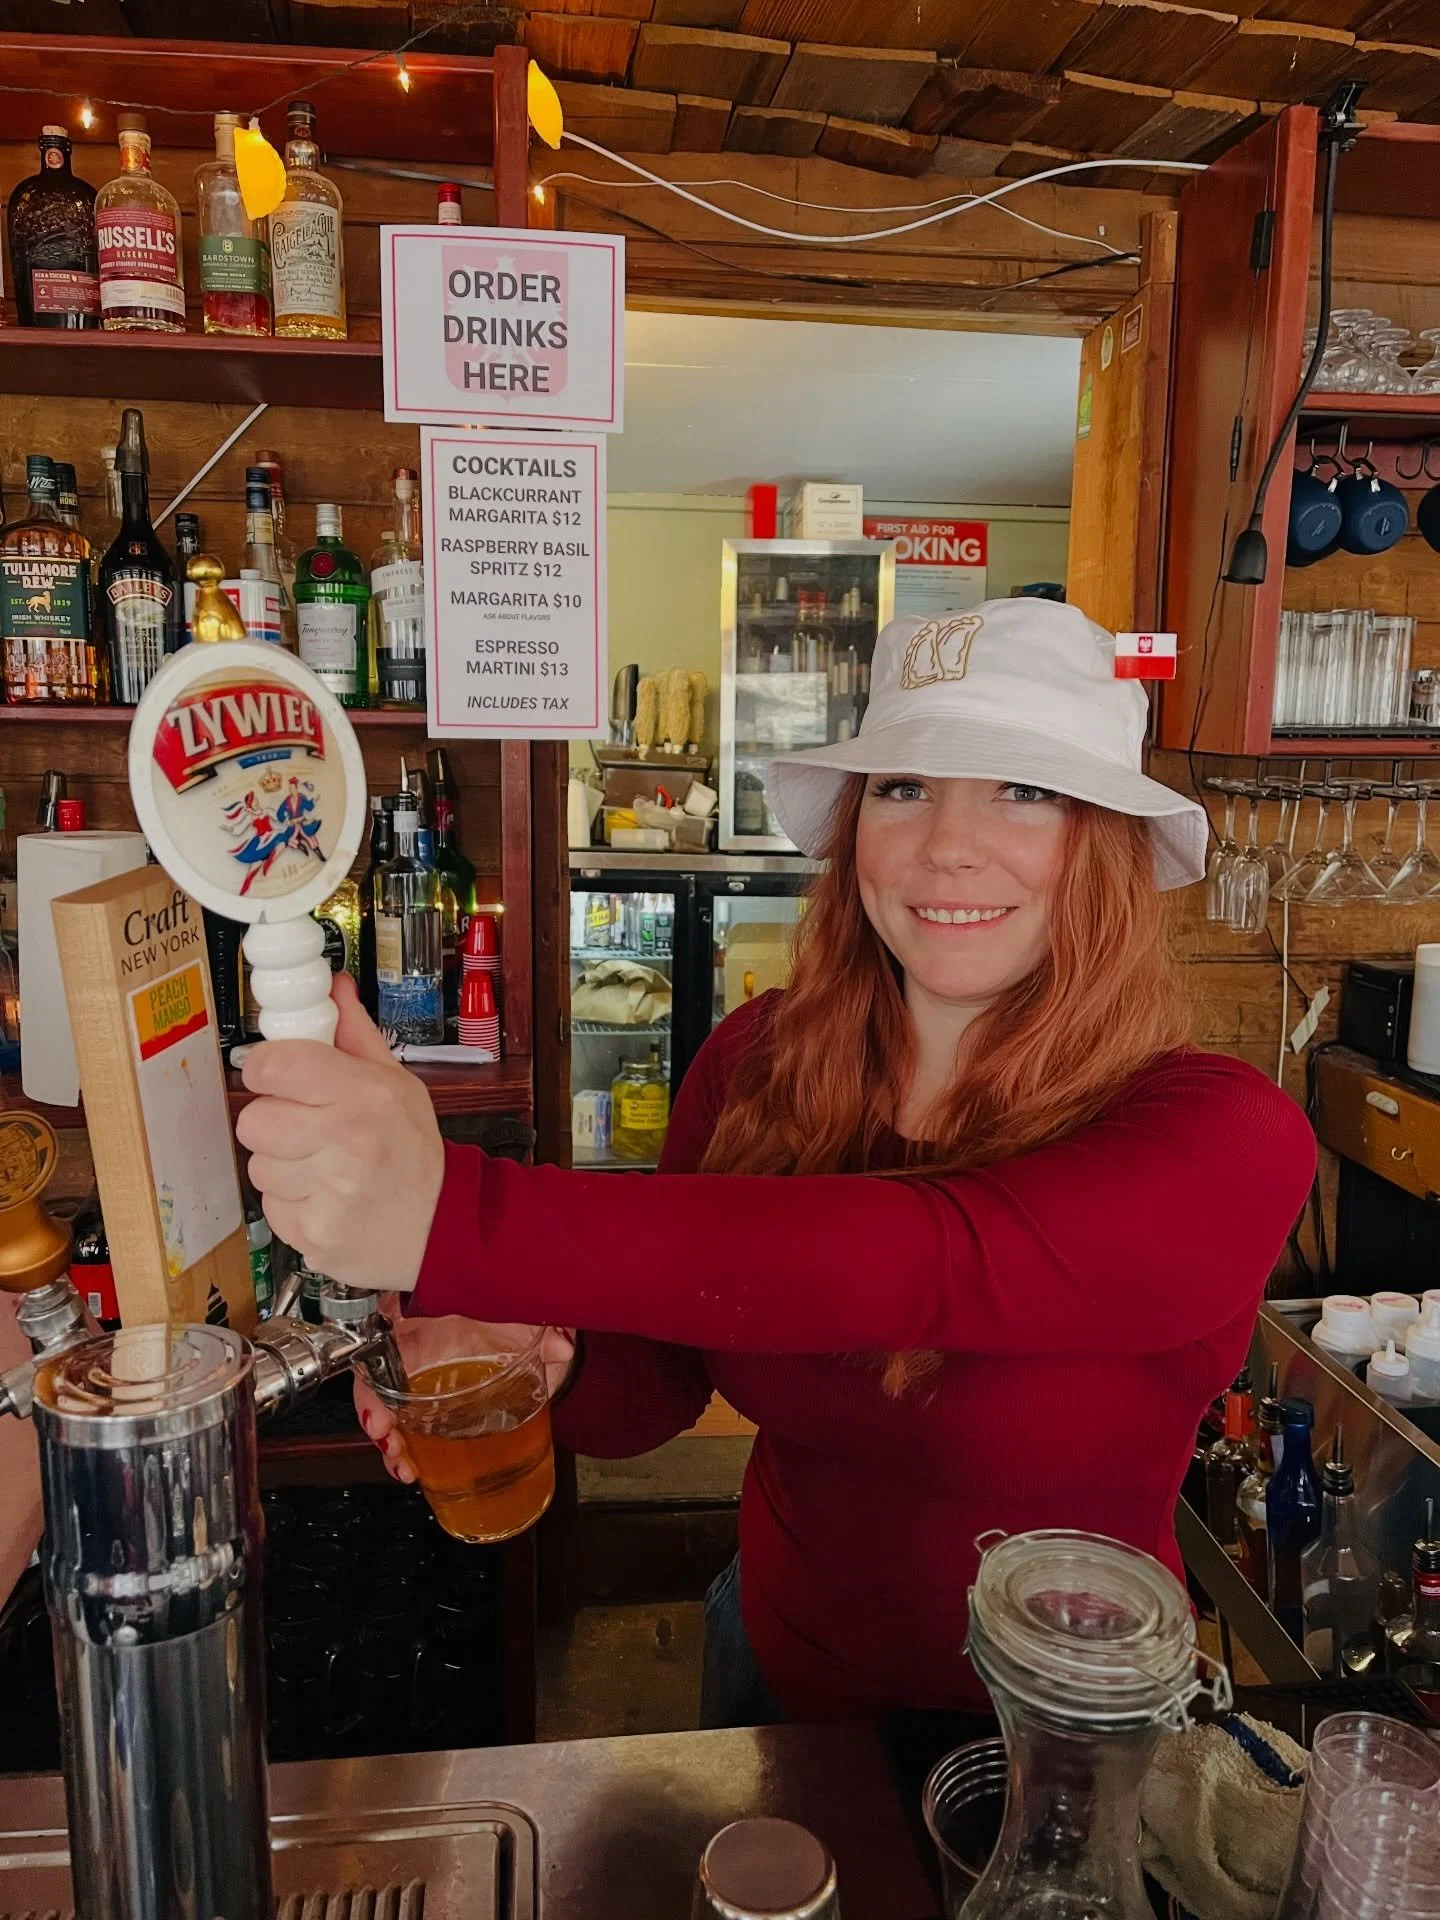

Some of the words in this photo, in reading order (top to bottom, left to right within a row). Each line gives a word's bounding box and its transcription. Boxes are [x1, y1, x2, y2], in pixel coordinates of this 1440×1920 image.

[98, 226, 175, 255] RUSSELL'S
[202, 254, 254, 264] BARDSTOWN
[448, 269, 561, 304] ORDER
[444, 314, 568, 350] DRINKS
[464, 361, 550, 393] HERE
[452, 455, 577, 478] COCKTAILS
[448, 485, 582, 504] BLACKCURRANT
[449, 507, 548, 524] MARGARITA
[552, 510, 582, 526] $12
[876, 523, 907, 533] FIRST
[910, 523, 930, 534] AID
[932, 525, 955, 536] FOR
[441, 537, 538, 555] RASPBERRY
[543, 542, 590, 557] BASIL
[2, 562, 77, 578] TULLAMORE
[470, 560, 528, 576] SPRITZ
[533, 562, 562, 578] $12
[110, 581, 168, 599] BAILEYS
[450, 590, 548, 607] MARGARITA
[553, 592, 582, 608] $10
[475, 639, 559, 655] ESPRESSO
[466, 660, 535, 676] MARTINI
[540, 660, 568, 677] $13
[467, 696, 538, 710] INCLUDES
[542, 697, 569, 710] TAX
[124, 890, 190, 946] Craft
[120, 947, 157, 976] NEW
[160, 925, 200, 956] YORK
[150, 975, 188, 1010] PEACH
[152, 996, 191, 1032] MANGO
